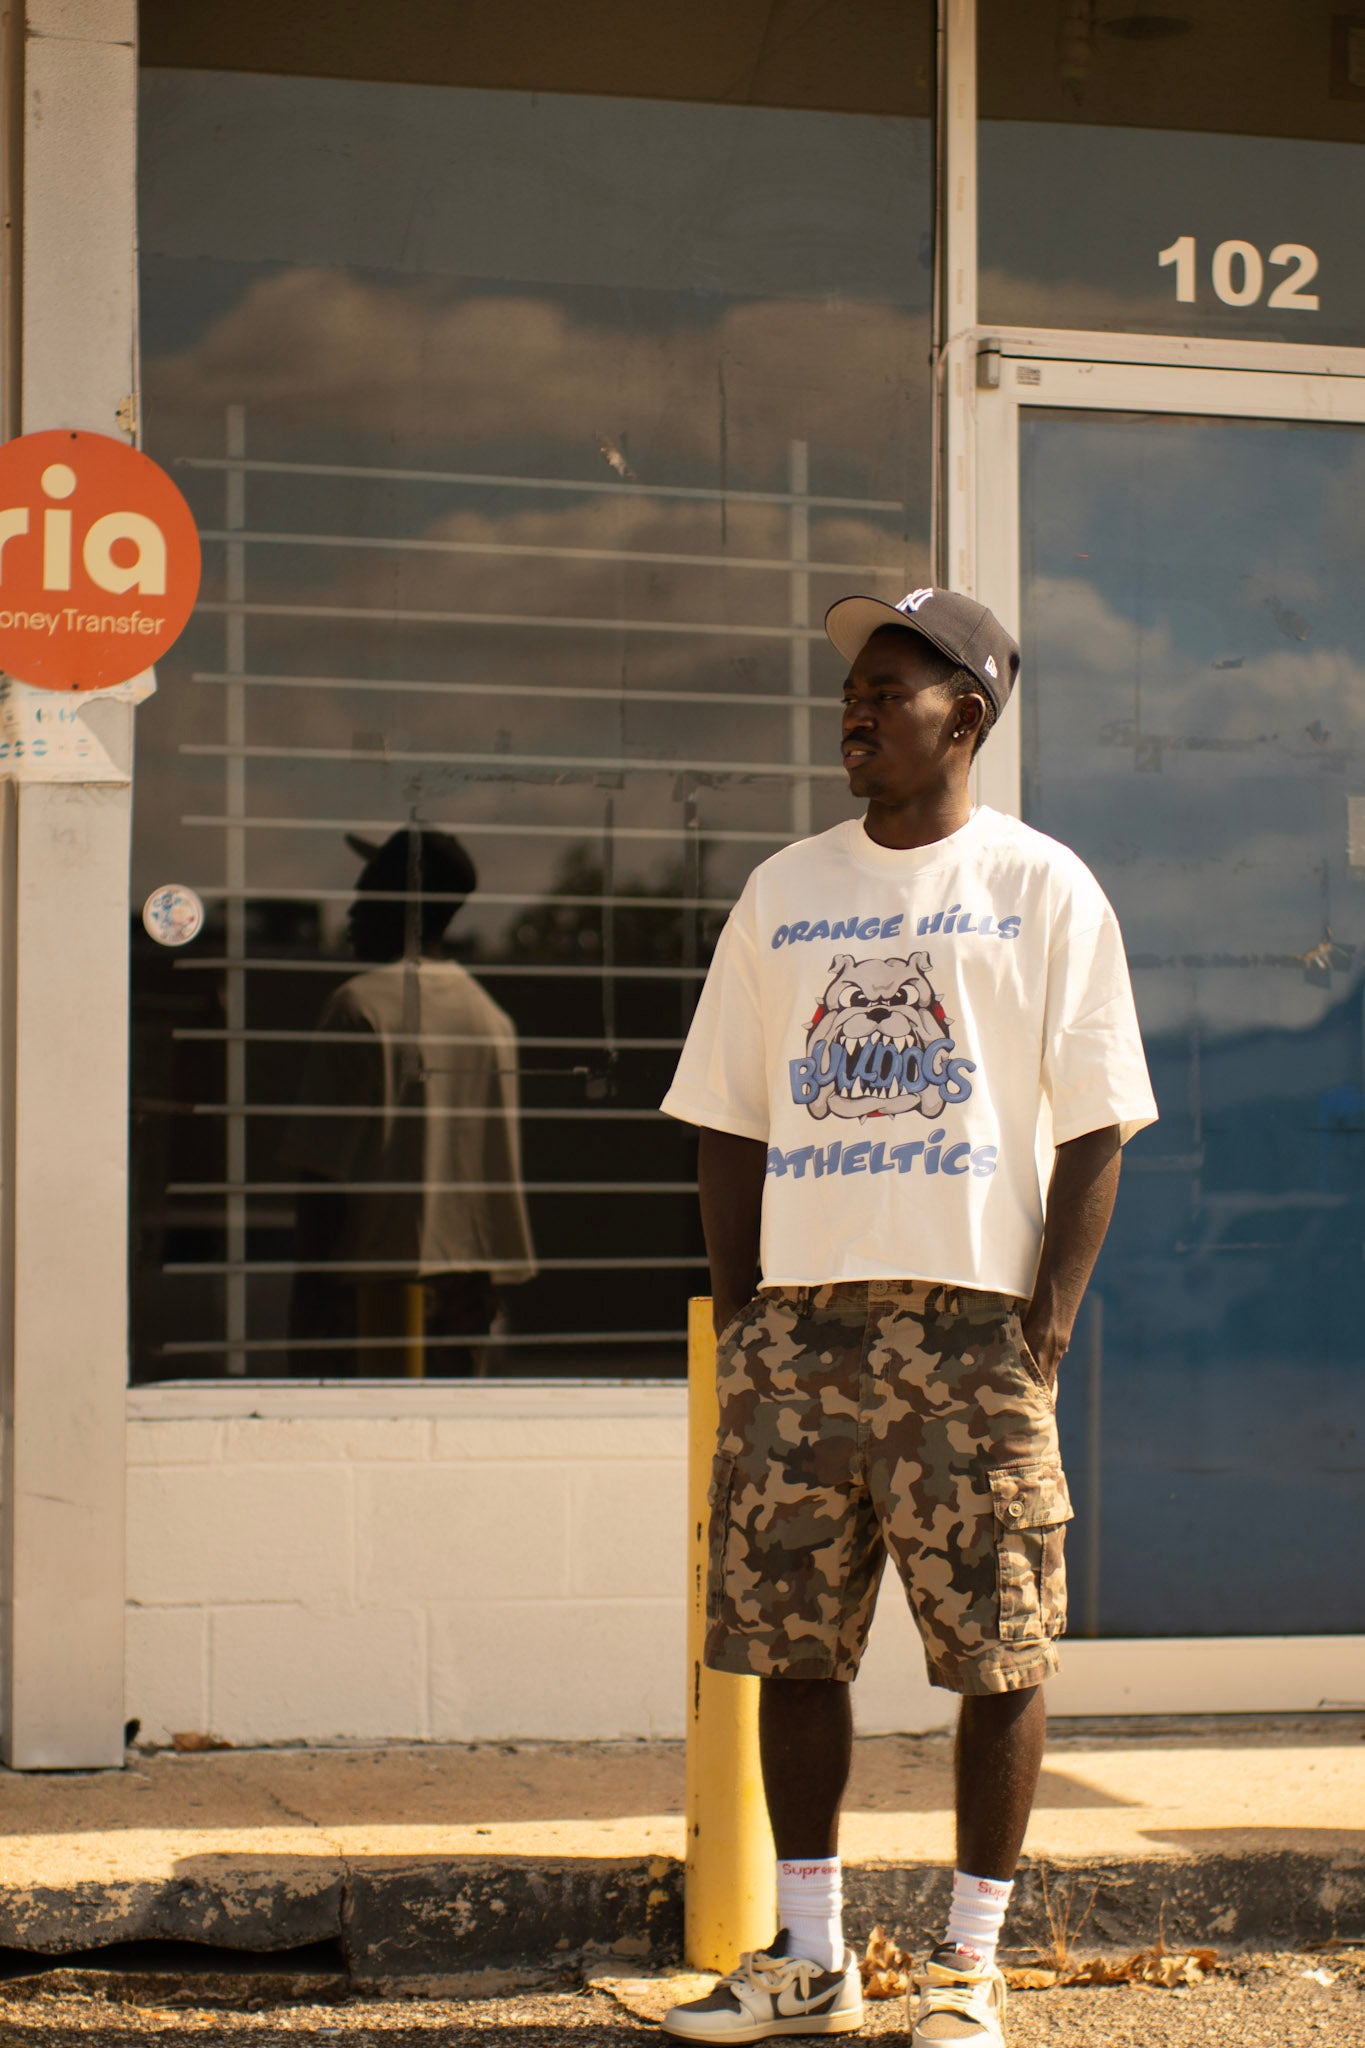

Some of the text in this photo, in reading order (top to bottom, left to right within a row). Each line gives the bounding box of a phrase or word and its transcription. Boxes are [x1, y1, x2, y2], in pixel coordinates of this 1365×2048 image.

[1158, 236, 1320, 310] 102
[62, 608, 165, 635] Transfer
[771, 914, 904, 949] ORANGE
[789, 1038, 976, 1104] BULLDOGS
